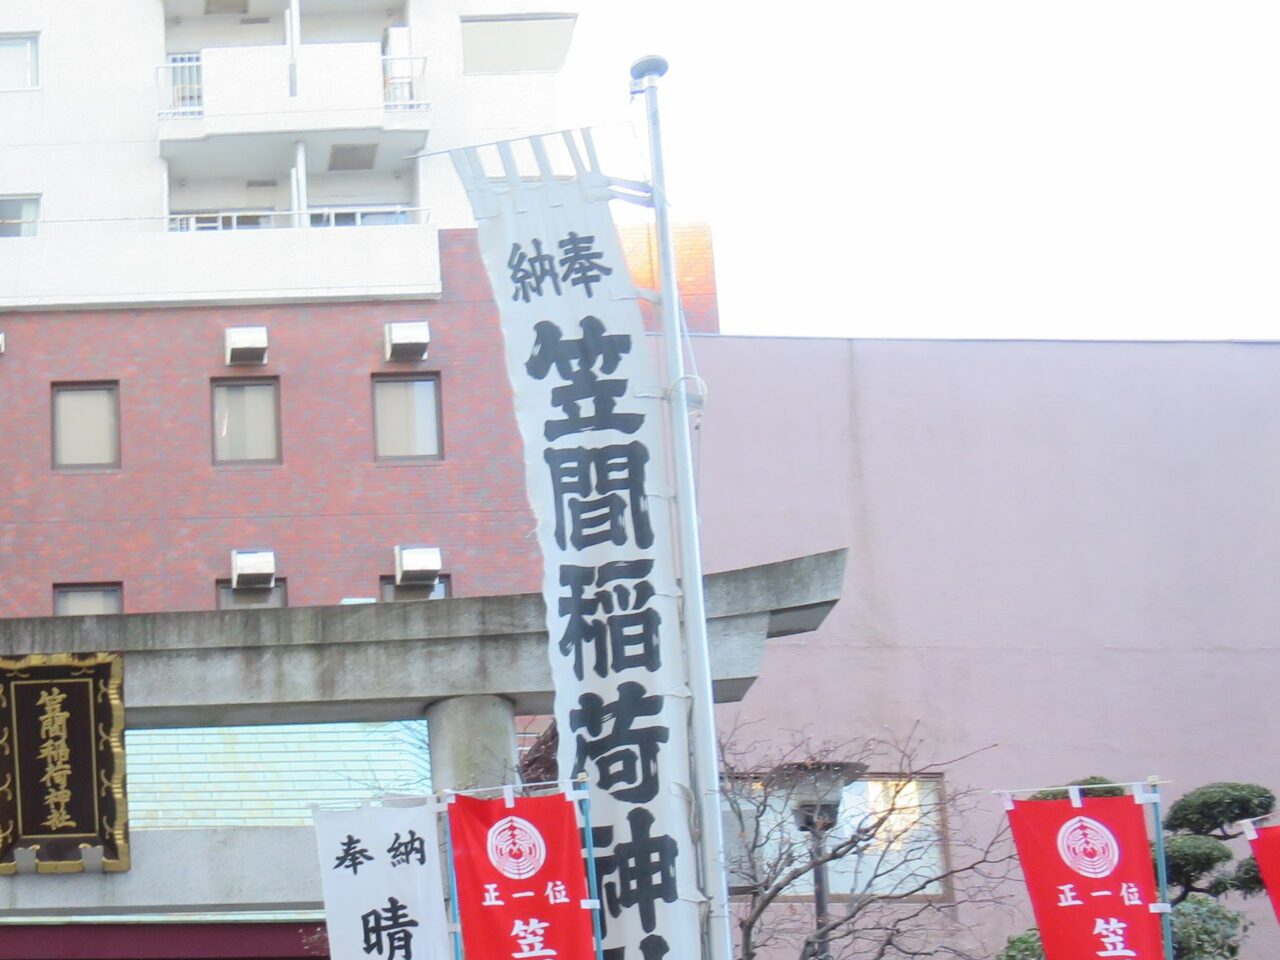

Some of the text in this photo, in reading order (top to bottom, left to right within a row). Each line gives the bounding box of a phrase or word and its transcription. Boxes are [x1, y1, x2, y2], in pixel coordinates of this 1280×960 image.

[507, 231, 613, 303] 奉納
[35, 687, 77, 830] 笠間稲荷神社
[332, 829, 426, 874] 奉納
[482, 880, 570, 906] 正一位
[1056, 882, 1143, 907] 正一位
